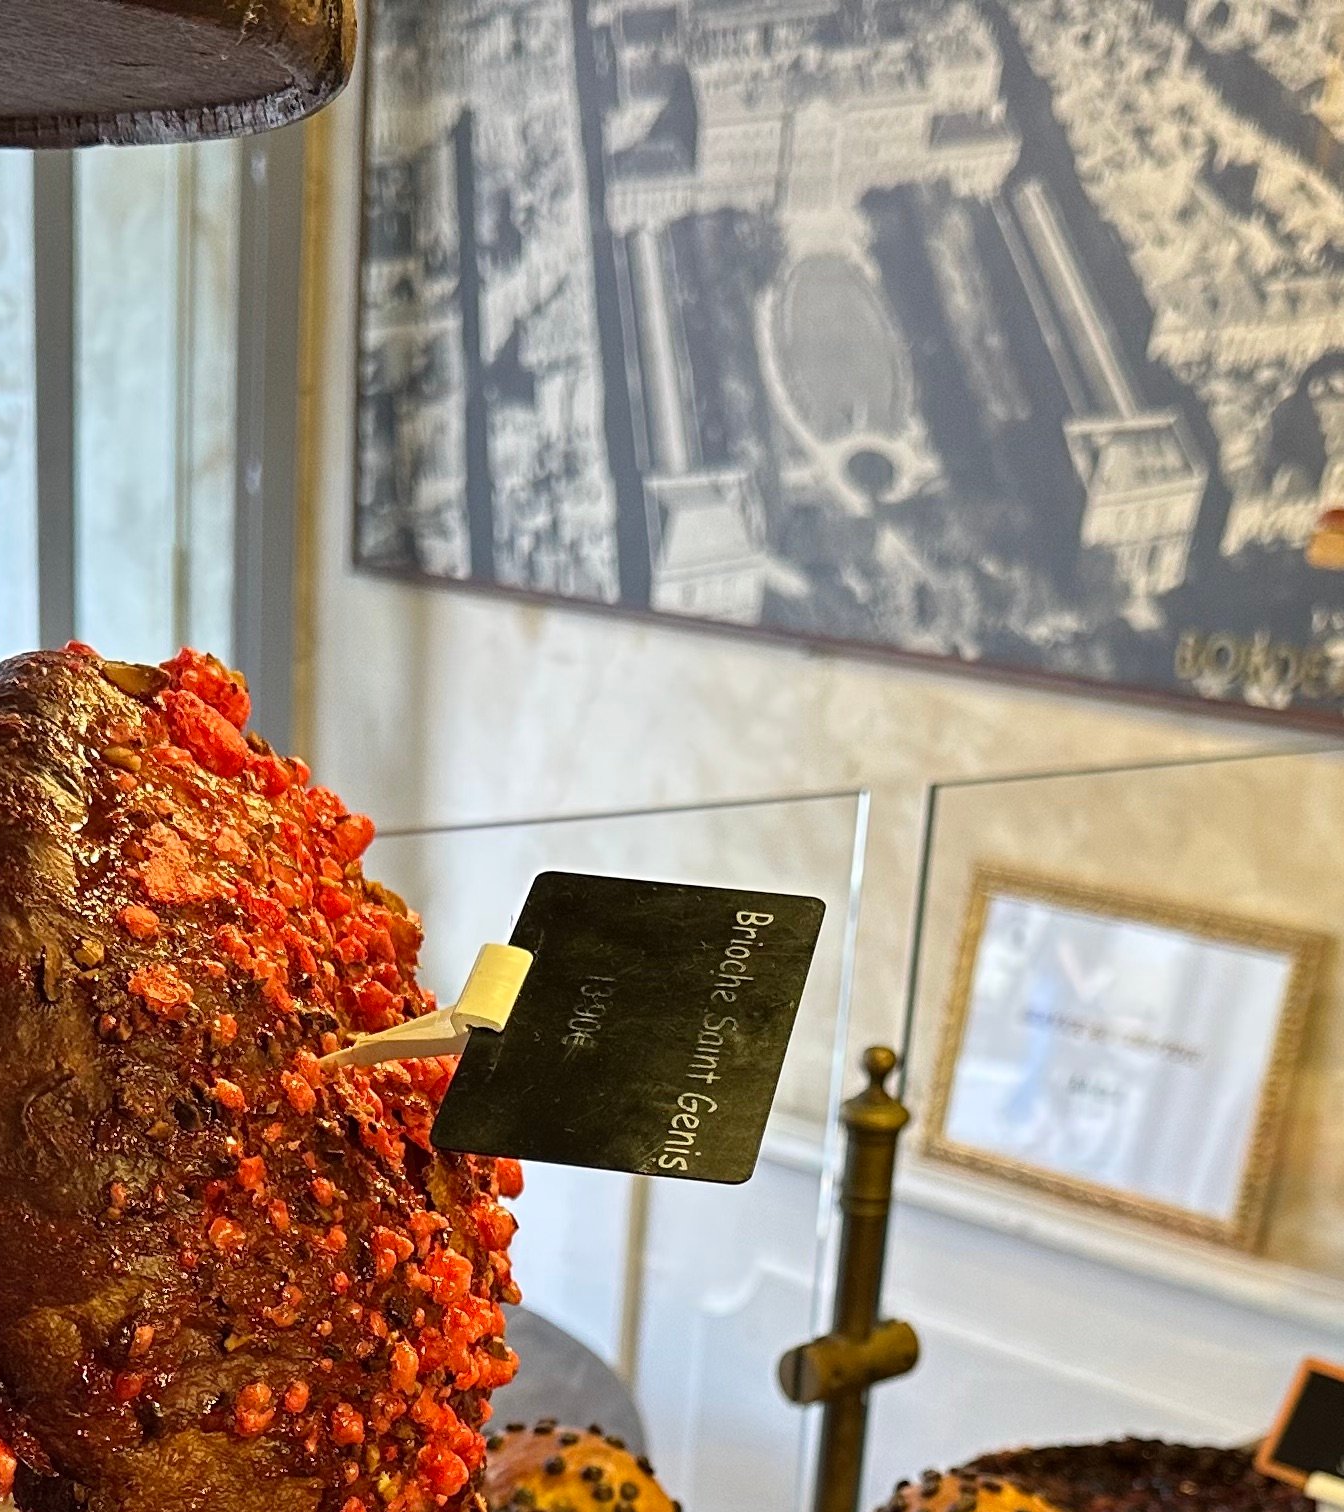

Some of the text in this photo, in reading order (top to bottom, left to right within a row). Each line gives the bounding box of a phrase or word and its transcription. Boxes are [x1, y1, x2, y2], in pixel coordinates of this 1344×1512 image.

[658, 909, 775, 1172] Brioche Saint Genis
